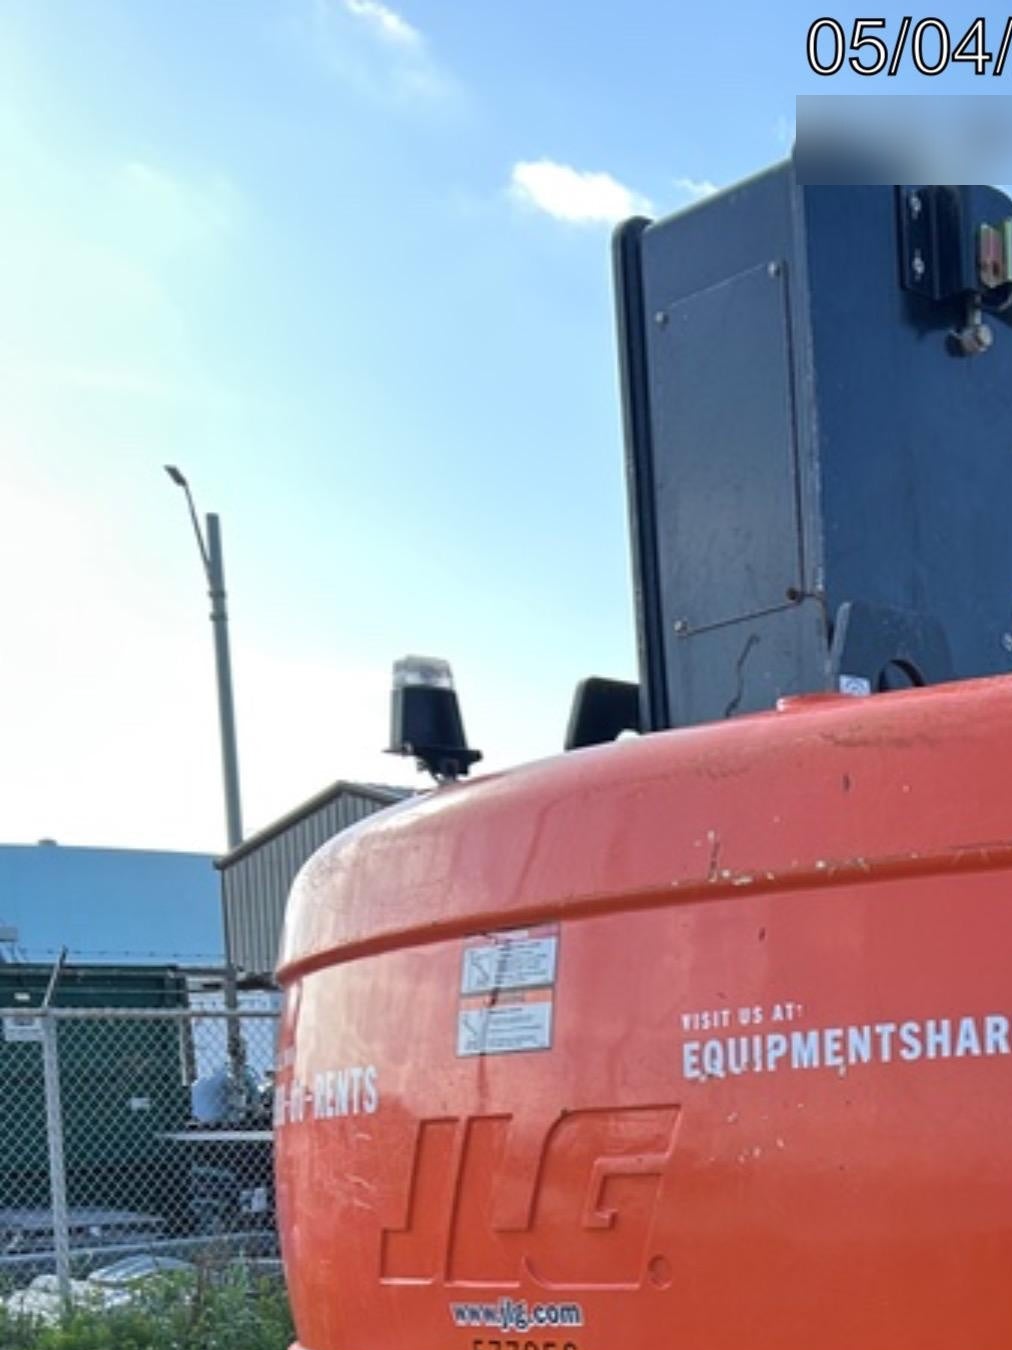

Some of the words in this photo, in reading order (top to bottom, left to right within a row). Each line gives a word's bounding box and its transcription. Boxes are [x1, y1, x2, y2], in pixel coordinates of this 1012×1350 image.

[681, 1009, 730, 1031] VISIT
[738, 1005, 763, 1026] US
[450, 1297, 583, 1332] www.jlg.com
